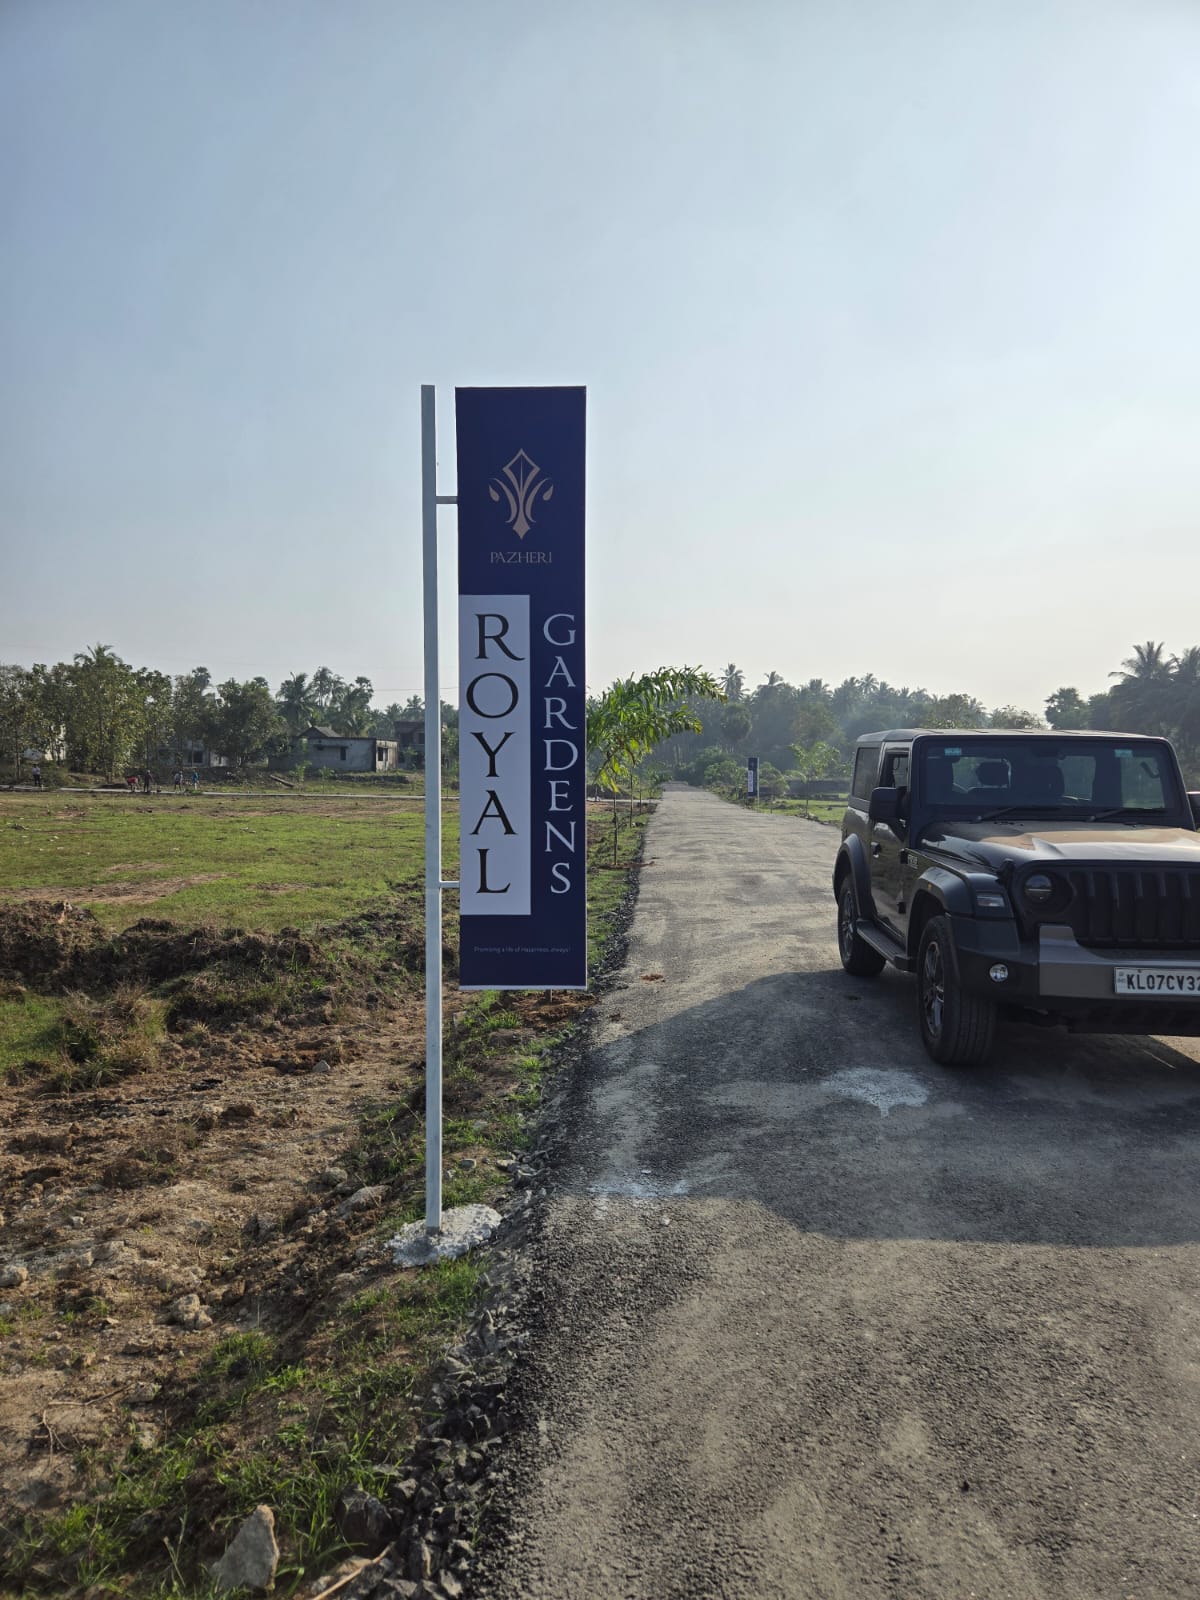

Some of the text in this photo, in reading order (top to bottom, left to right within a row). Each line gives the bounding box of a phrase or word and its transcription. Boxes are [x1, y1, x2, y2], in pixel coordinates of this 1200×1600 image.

[490, 551, 553, 564] PAZHERI
[466, 613, 526, 894] ROYAL
[543, 613, 579, 894] GARDENS
